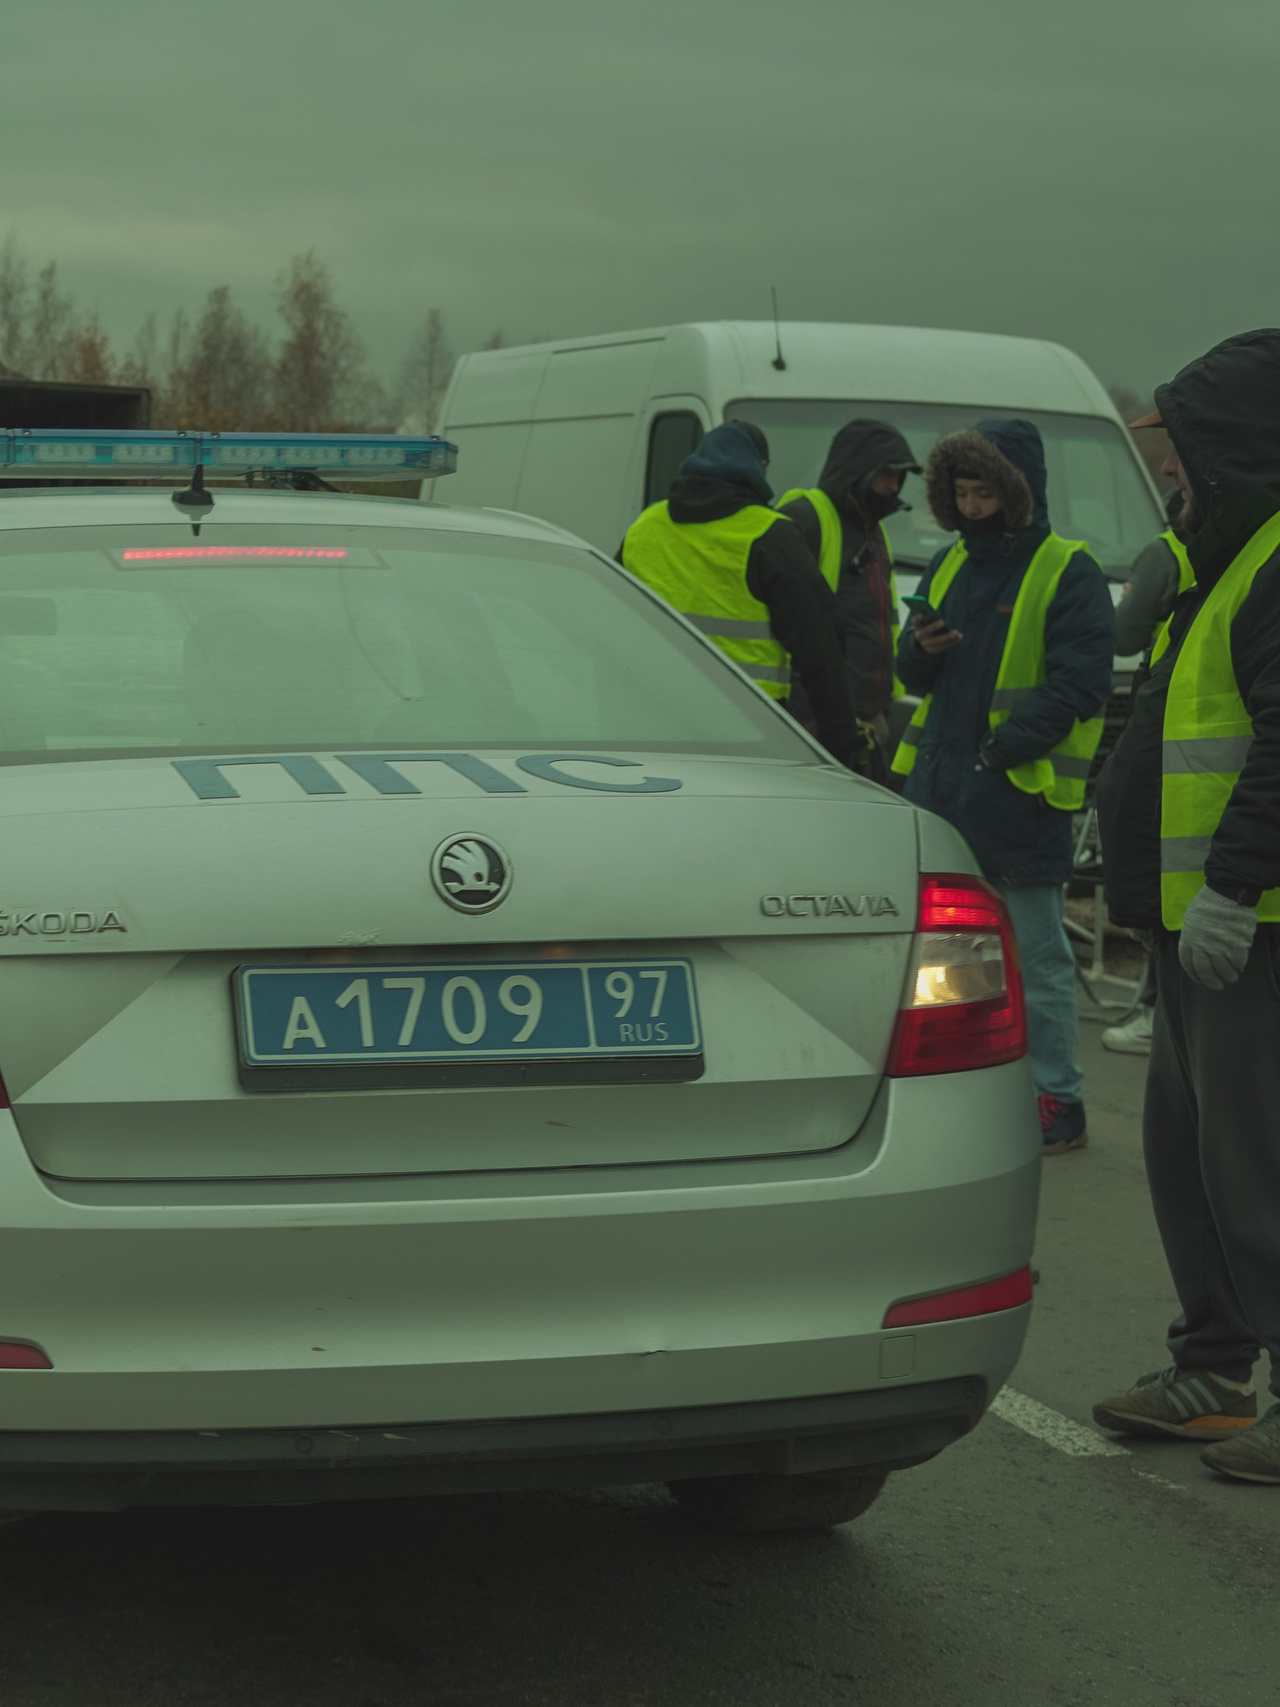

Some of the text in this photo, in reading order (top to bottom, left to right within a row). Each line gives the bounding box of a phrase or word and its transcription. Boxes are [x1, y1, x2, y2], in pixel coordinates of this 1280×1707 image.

[169, 753, 683, 800] ППС
[759, 893, 900, 918] OCTAVIA
[604, 970, 669, 1019] 97
[619, 1021, 670, 1043] RUS
